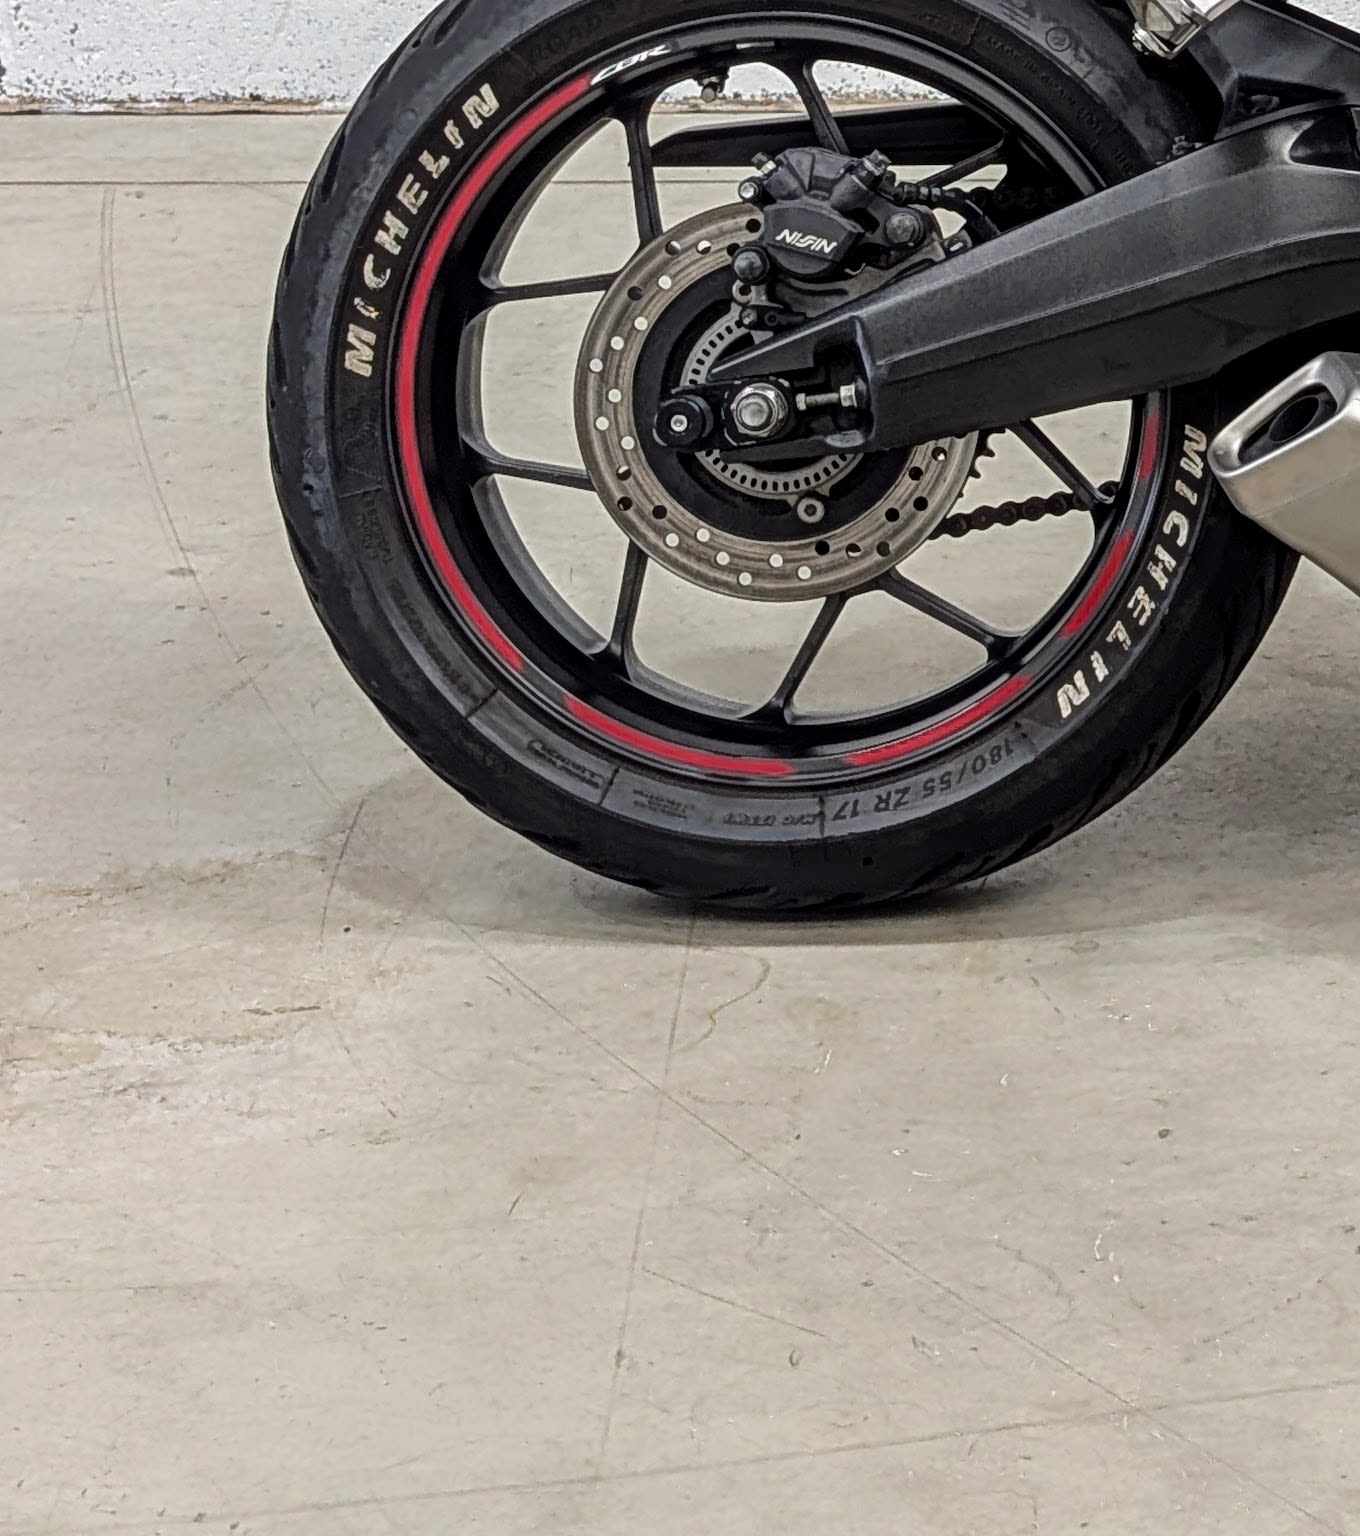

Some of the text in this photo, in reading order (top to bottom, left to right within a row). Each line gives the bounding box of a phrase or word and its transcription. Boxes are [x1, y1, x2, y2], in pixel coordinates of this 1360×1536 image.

[344, 82, 501, 378] MICHELIN
[774, 228, 839, 254] NISSIN
[1056, 424, 1207, 719] MICHELIN
[831, 737, 1015, 822] 180/55 ZR 17
